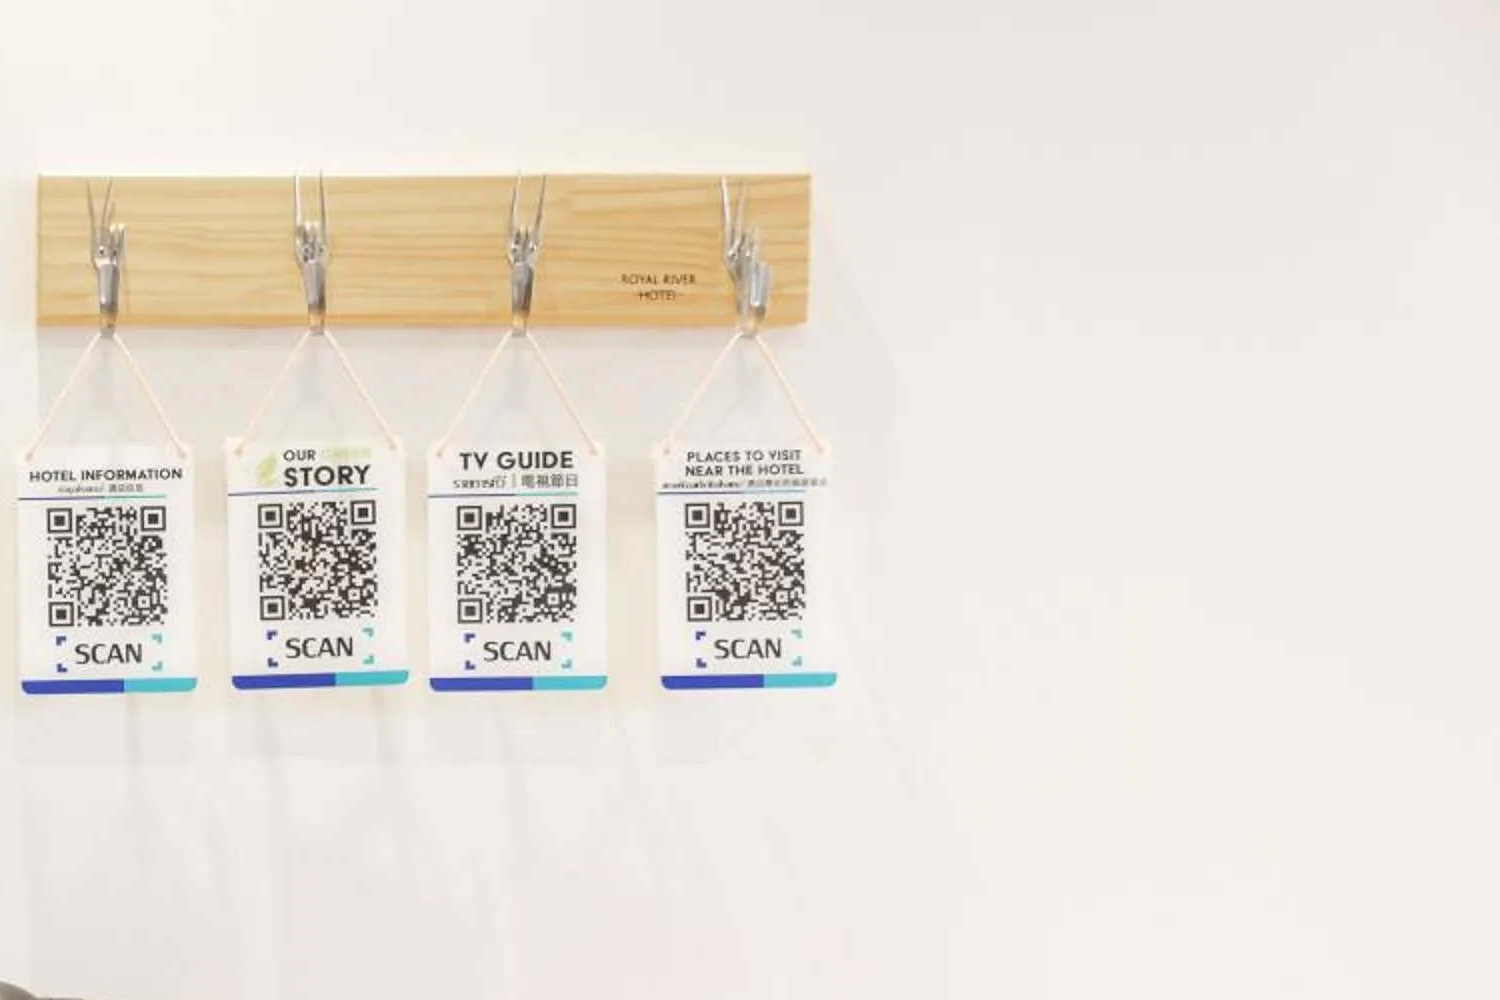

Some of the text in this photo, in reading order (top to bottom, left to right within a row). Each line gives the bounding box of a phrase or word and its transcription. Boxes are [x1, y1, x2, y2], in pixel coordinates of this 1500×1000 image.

[620, 273, 696, 285] ROYAL RIVER
[283, 449, 316, 461] OUR
[459, 451, 574, 470] TV GUIDE
[687, 449, 803, 463] PLACES TO VISIT
[29, 467, 183, 483] HOTEL INFORMATION
[284, 464, 371, 487] STORY
[685, 463, 804, 477] NEAR THE HOTEL
[74, 643, 144, 665] SCAN
[284, 636, 355, 659] SCAN
[483, 640, 552, 662] SCAN
[713, 638, 783, 660] SCAN
